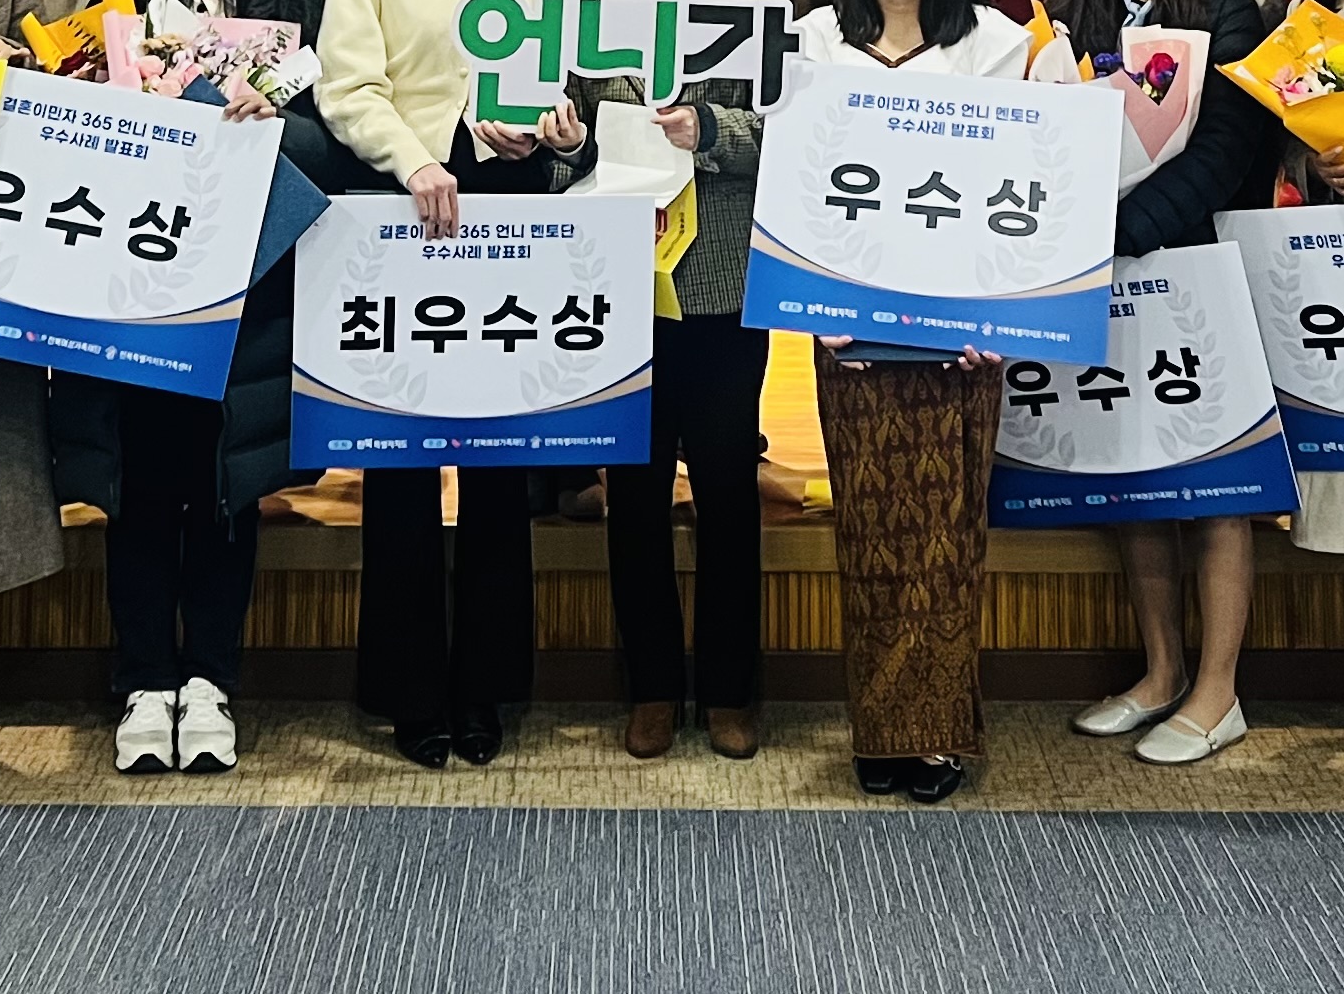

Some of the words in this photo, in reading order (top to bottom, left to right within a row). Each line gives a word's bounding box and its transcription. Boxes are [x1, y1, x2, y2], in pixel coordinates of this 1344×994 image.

[847, 94, 919, 111] 결혼이민자
[926, 101, 954, 115] 365
[962, 102, 988, 117] 언니
[995, 109, 1039, 125] 멘토단
[3, 97, 76, 123] 결혼이민자
[82, 113, 112, 130] 365
[118, 119, 146, 137] 언니
[152, 126, 196, 146] 멘토단
[889, 118, 945, 136] 우수사례
[952, 124, 993, 139] 발표회
[41, 127, 99, 150] 우수사례
[105, 139, 148, 159] 발표회
[460, 225, 490, 238] 365
[496, 224, 524, 238] 언니
[531, 224, 574, 238] 멘토단
[422, 245, 481, 259] 우수사례
[488, 245, 530, 259] 발표회
[1128, 279, 1169, 296] 멘토단
[1109, 303, 1135, 318] 표회
[339, 295, 611, 354] 최우수상
